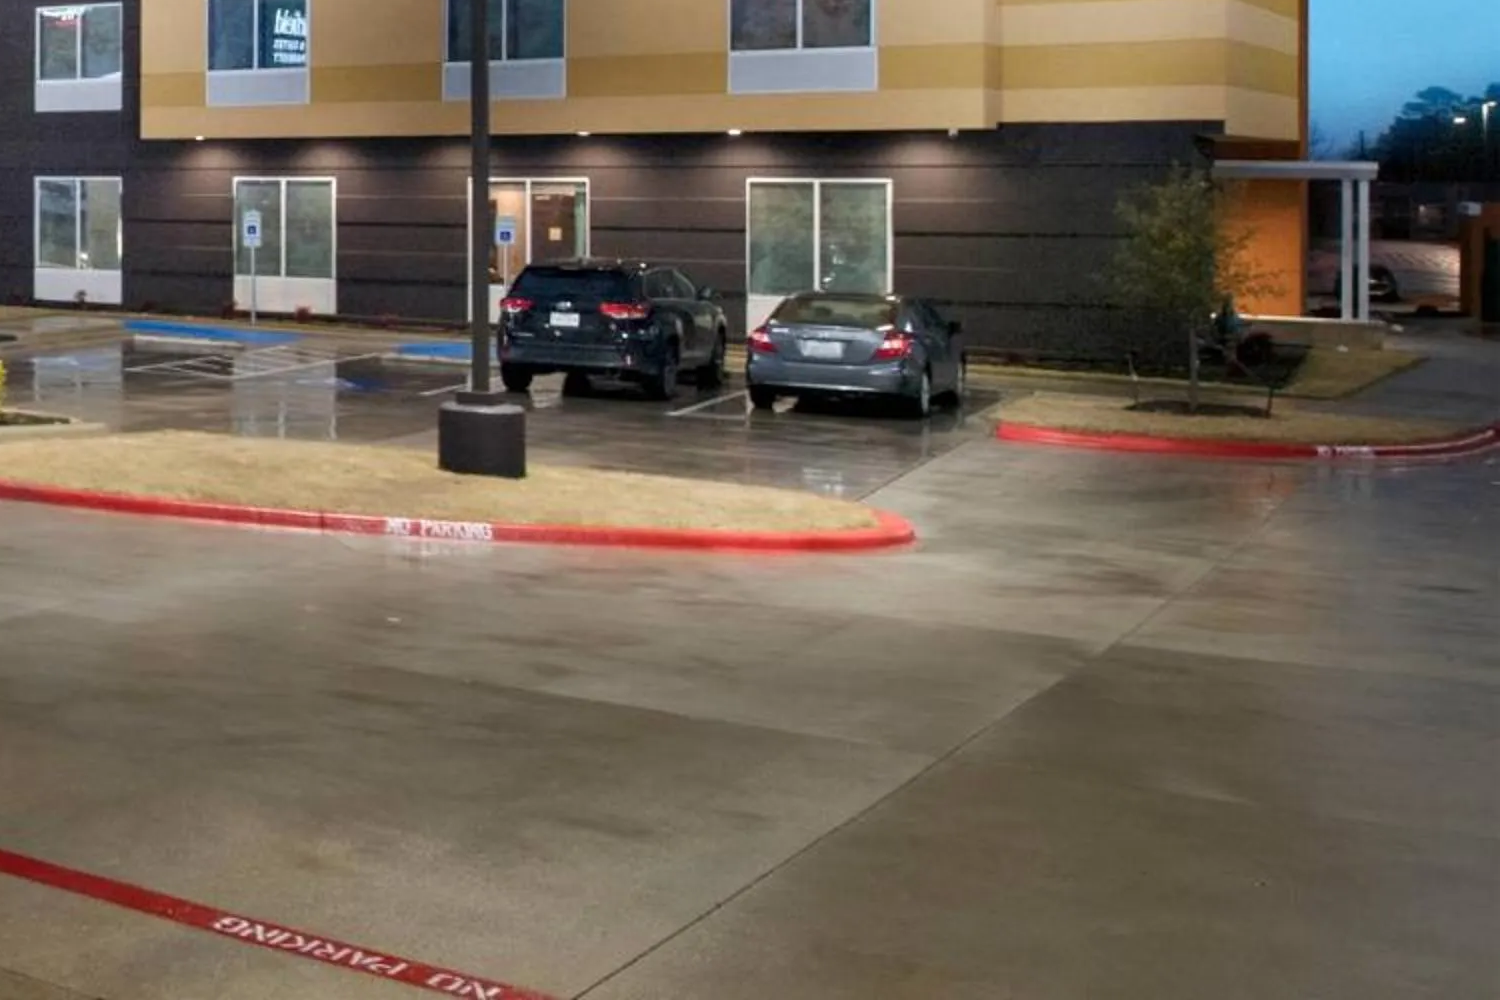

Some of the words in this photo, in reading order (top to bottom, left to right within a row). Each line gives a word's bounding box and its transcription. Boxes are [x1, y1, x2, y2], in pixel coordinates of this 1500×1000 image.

[419, 519, 493, 541] PARKING
[213, 916, 408, 976] PARKING
[426, 973, 501, 1000] NO
